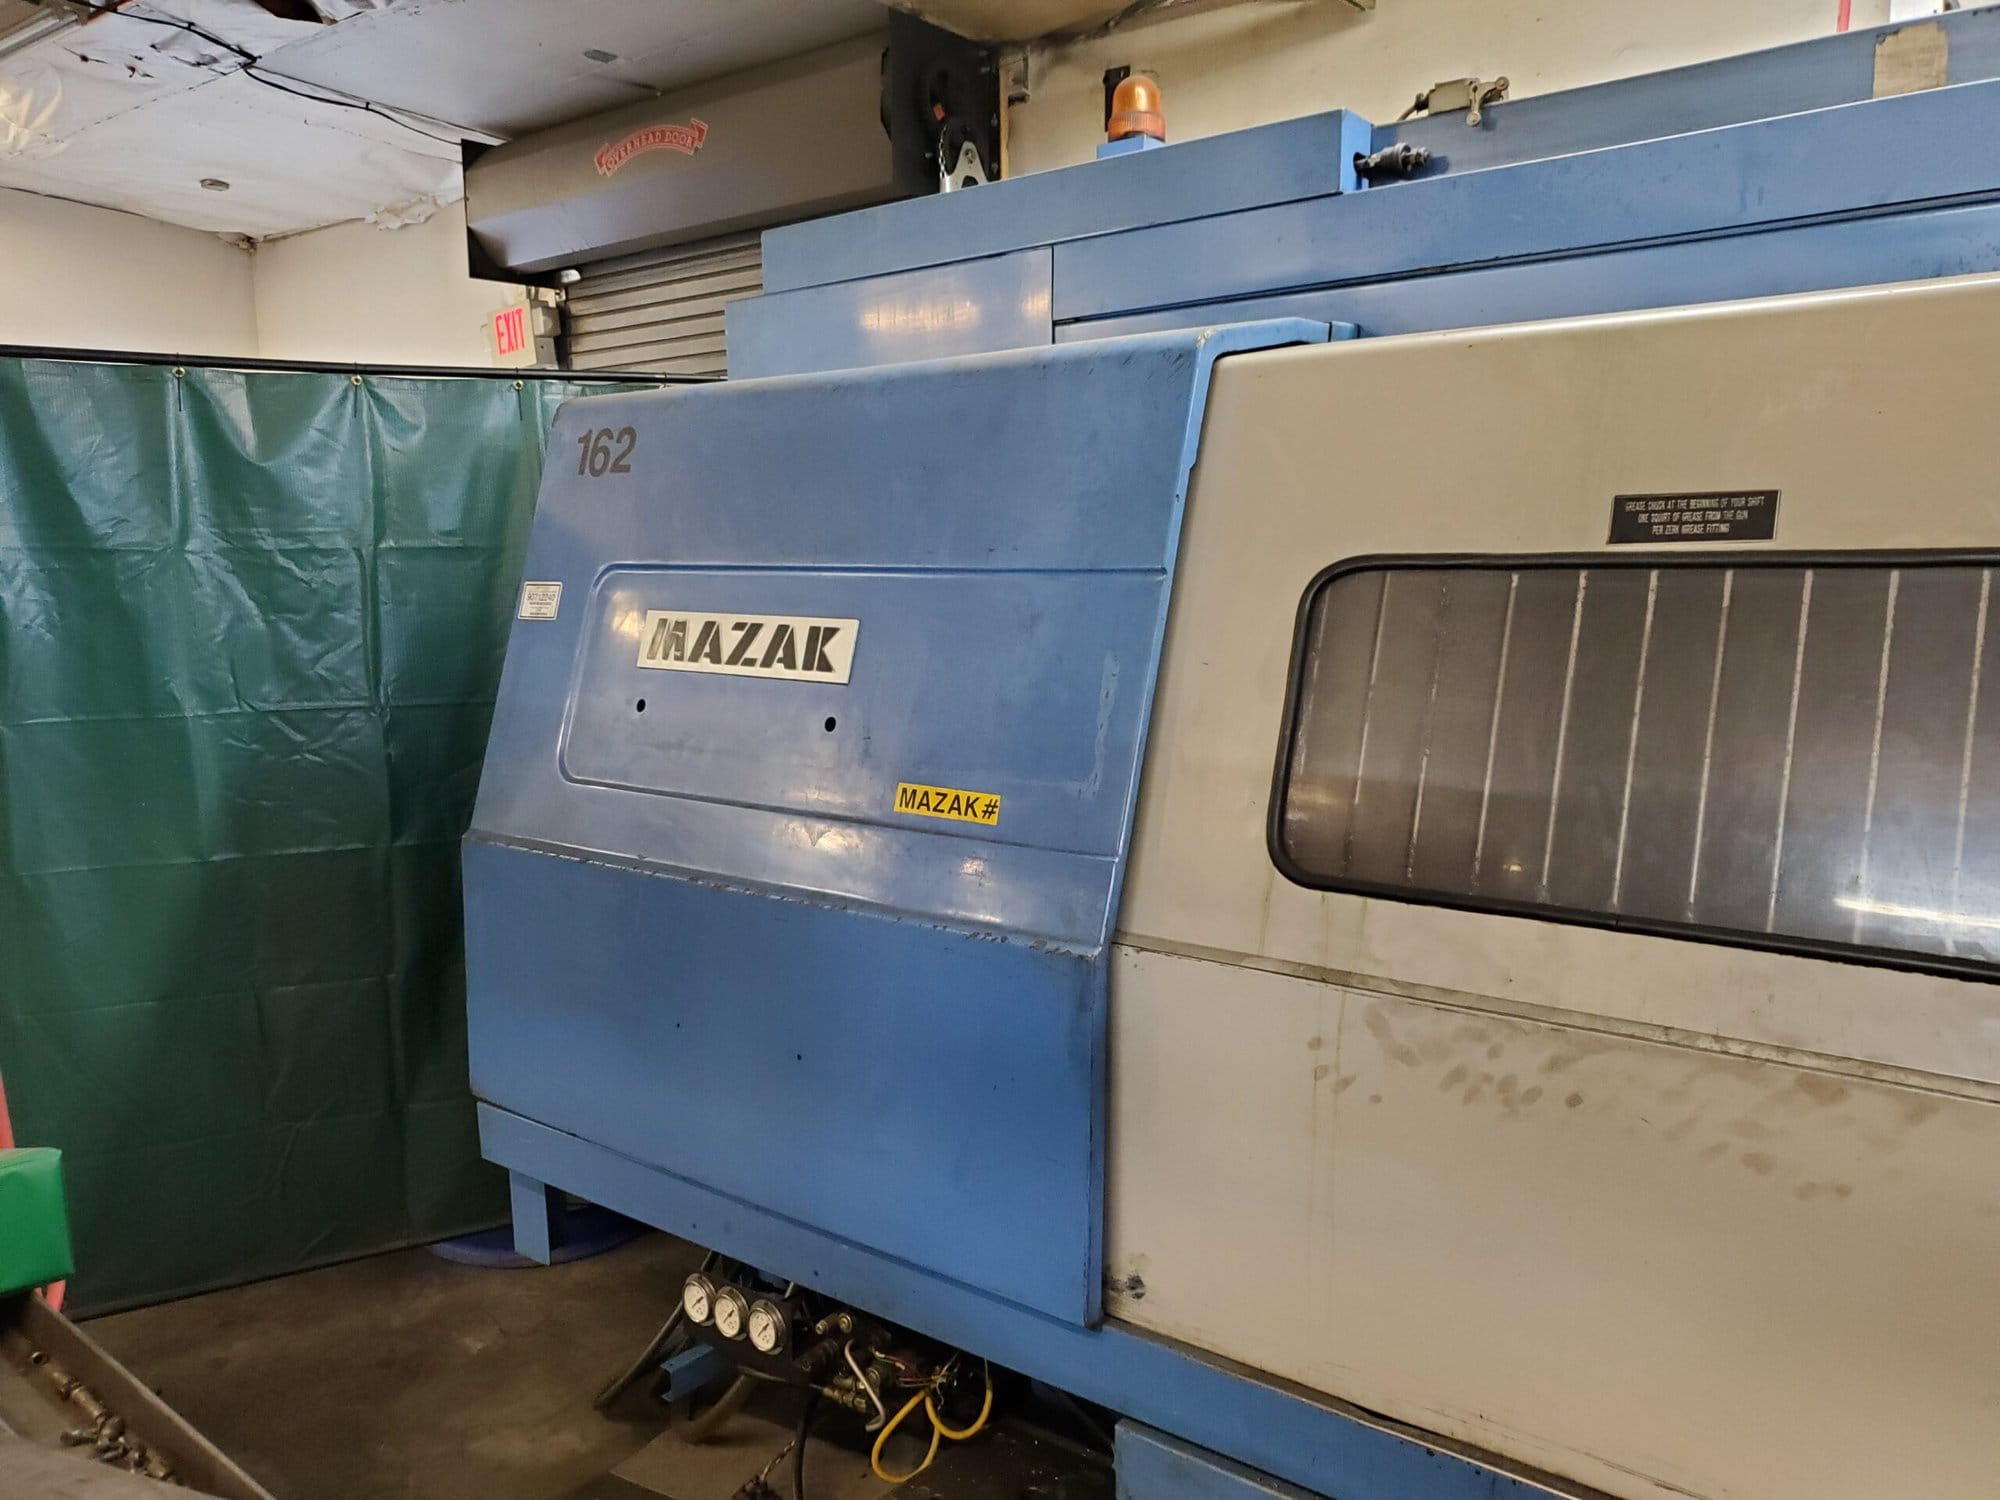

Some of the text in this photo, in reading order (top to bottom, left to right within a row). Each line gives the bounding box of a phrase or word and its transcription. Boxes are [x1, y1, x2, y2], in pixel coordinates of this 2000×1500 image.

[605, 131, 694, 169] OVERHEAD DOOR
[495, 308, 526, 356] EXIT
[577, 426, 637, 478] 162
[1672, 511, 1681, 522] OF
[1681, 511, 1703, 522] GREASE
[1705, 511, 1721, 521] FROM
[1723, 510, 1735, 520] THE
[1677, 499, 1688, 510] THE
[646, 617, 841, 673] MAZAK
[899, 787, 999, 820] MAZAK#
